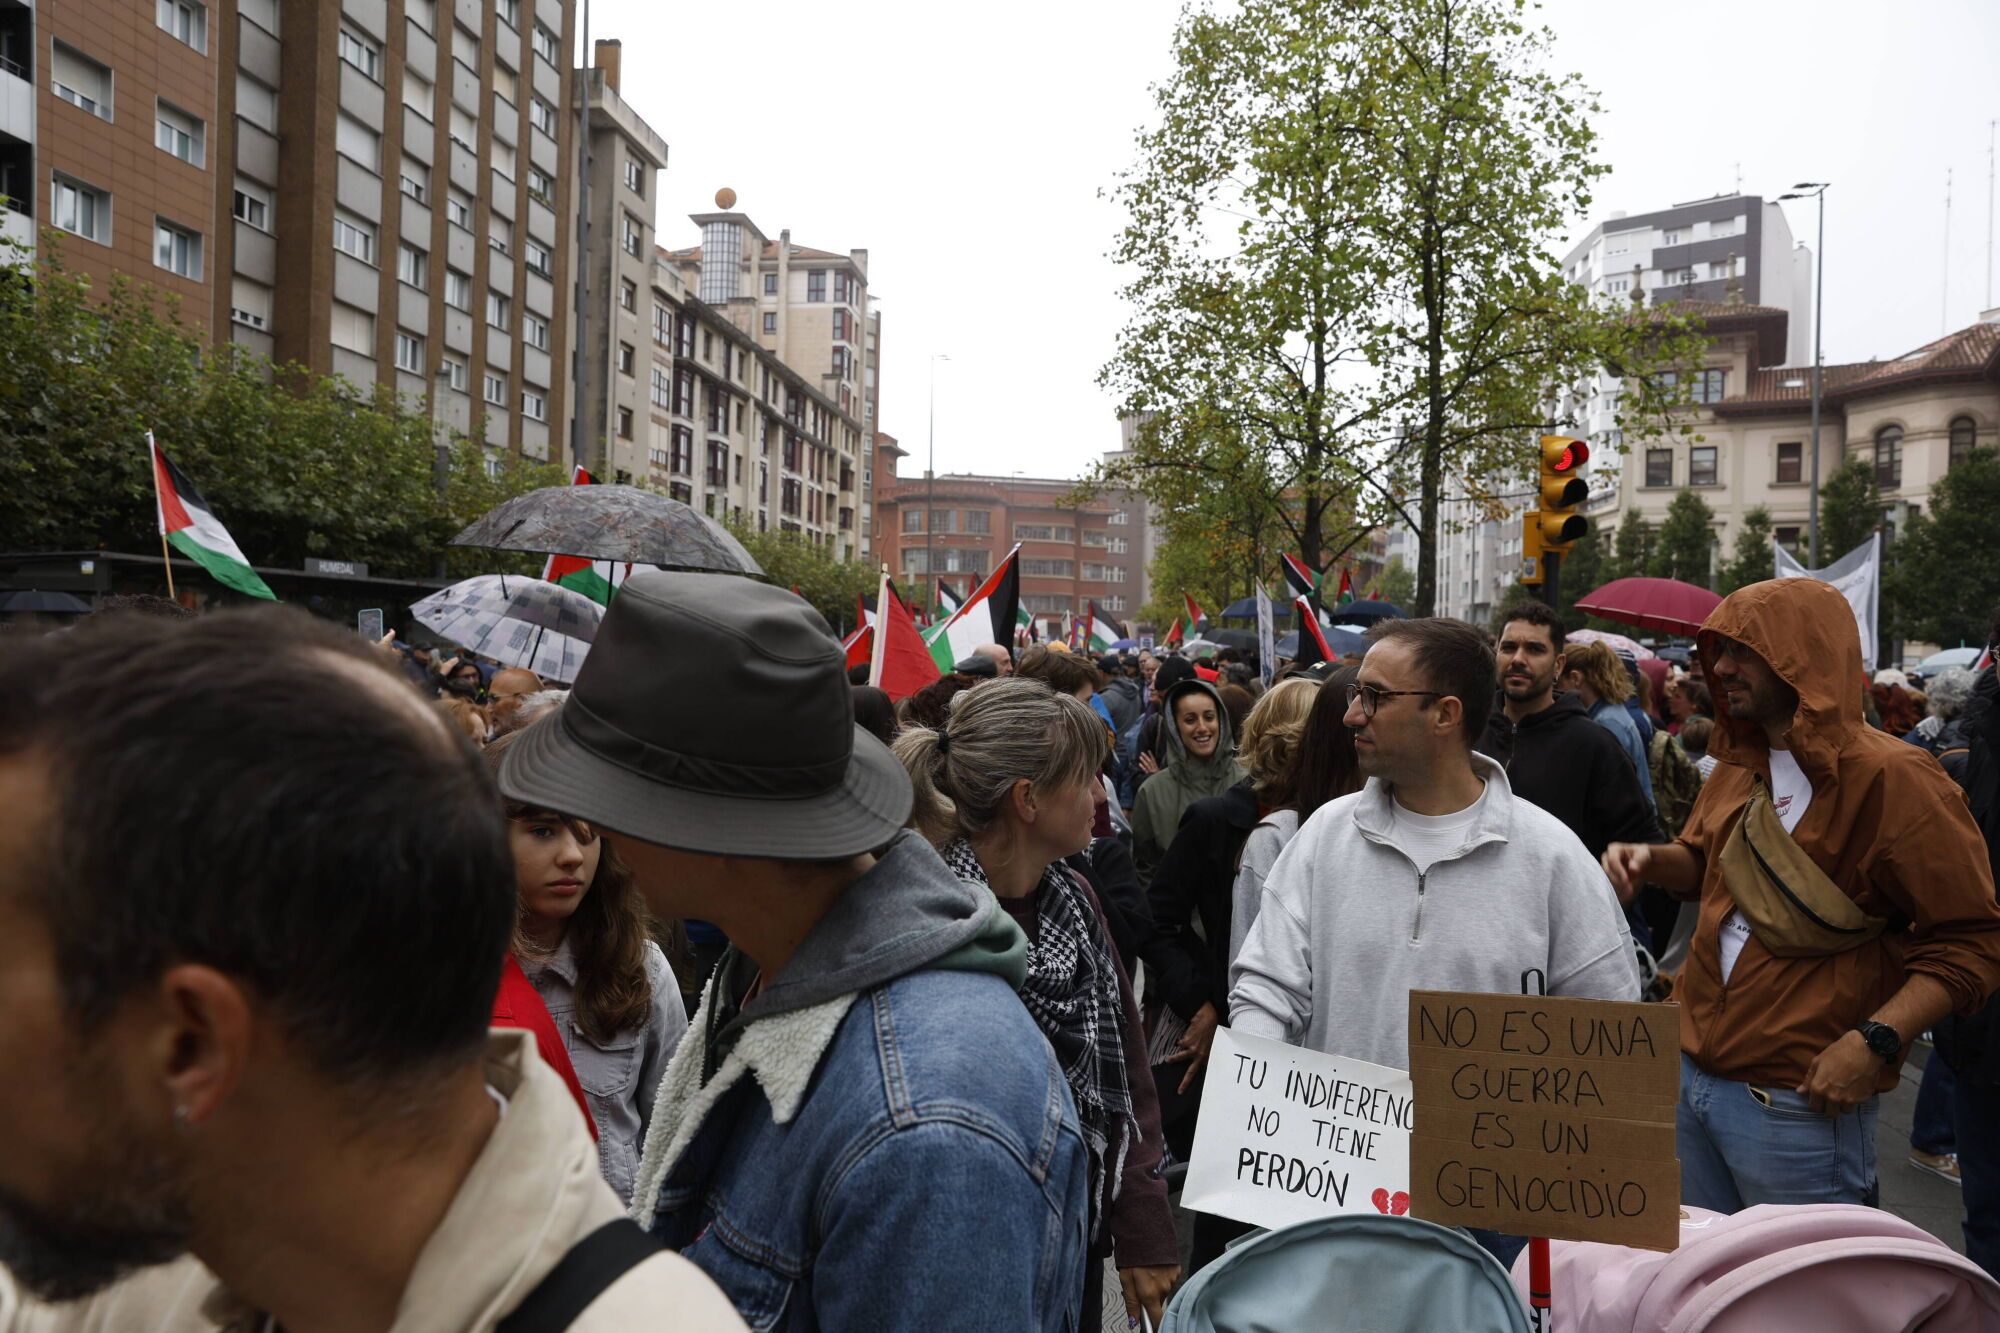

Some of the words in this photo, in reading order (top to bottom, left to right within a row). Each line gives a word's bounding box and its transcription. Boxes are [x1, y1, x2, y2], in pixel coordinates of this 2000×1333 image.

[318, 559, 355, 575] HUMEDAL
[1420, 1004, 1477, 1047] NO
[1500, 1010, 1551, 1055] ES
[1570, 1015, 1656, 1058] UNA
[1233, 1053, 1267, 1090] TU
[1451, 1063, 1604, 1107] GUERRA
[1247, 1104, 1280, 1137] NO
[1312, 1116, 1382, 1161] TIENE
[1471, 1112, 1515, 1149] ES
[1542, 1119, 1589, 1155] UN
[1237, 1147, 1350, 1207] PERDÓN
[1436, 1160, 1647, 1218] GENOCIDIO
